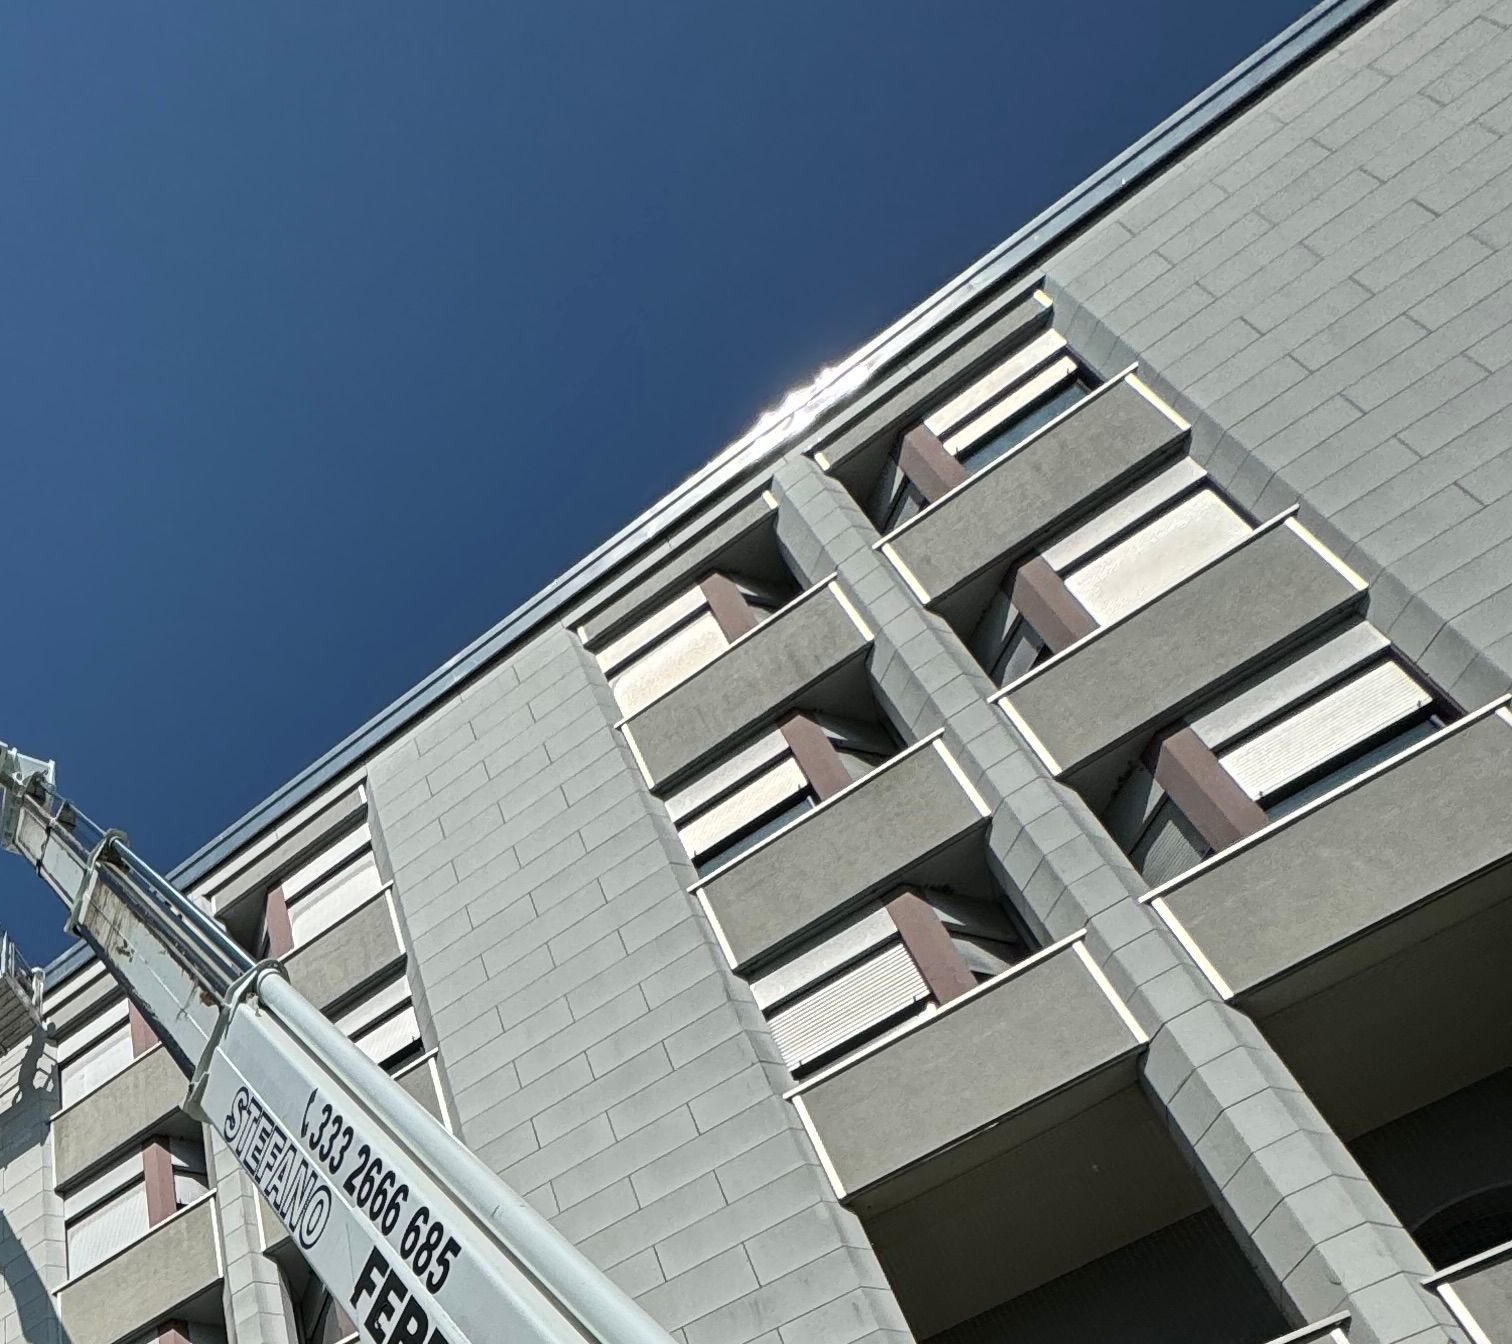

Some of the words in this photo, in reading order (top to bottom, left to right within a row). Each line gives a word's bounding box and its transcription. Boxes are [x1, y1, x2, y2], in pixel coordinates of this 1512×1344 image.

[224, 1086, 332, 1250] STEFANO
[309, 1103, 354, 1175] 333
[342, 1144, 409, 1236] 2666
[400, 1206, 462, 1295] 685
